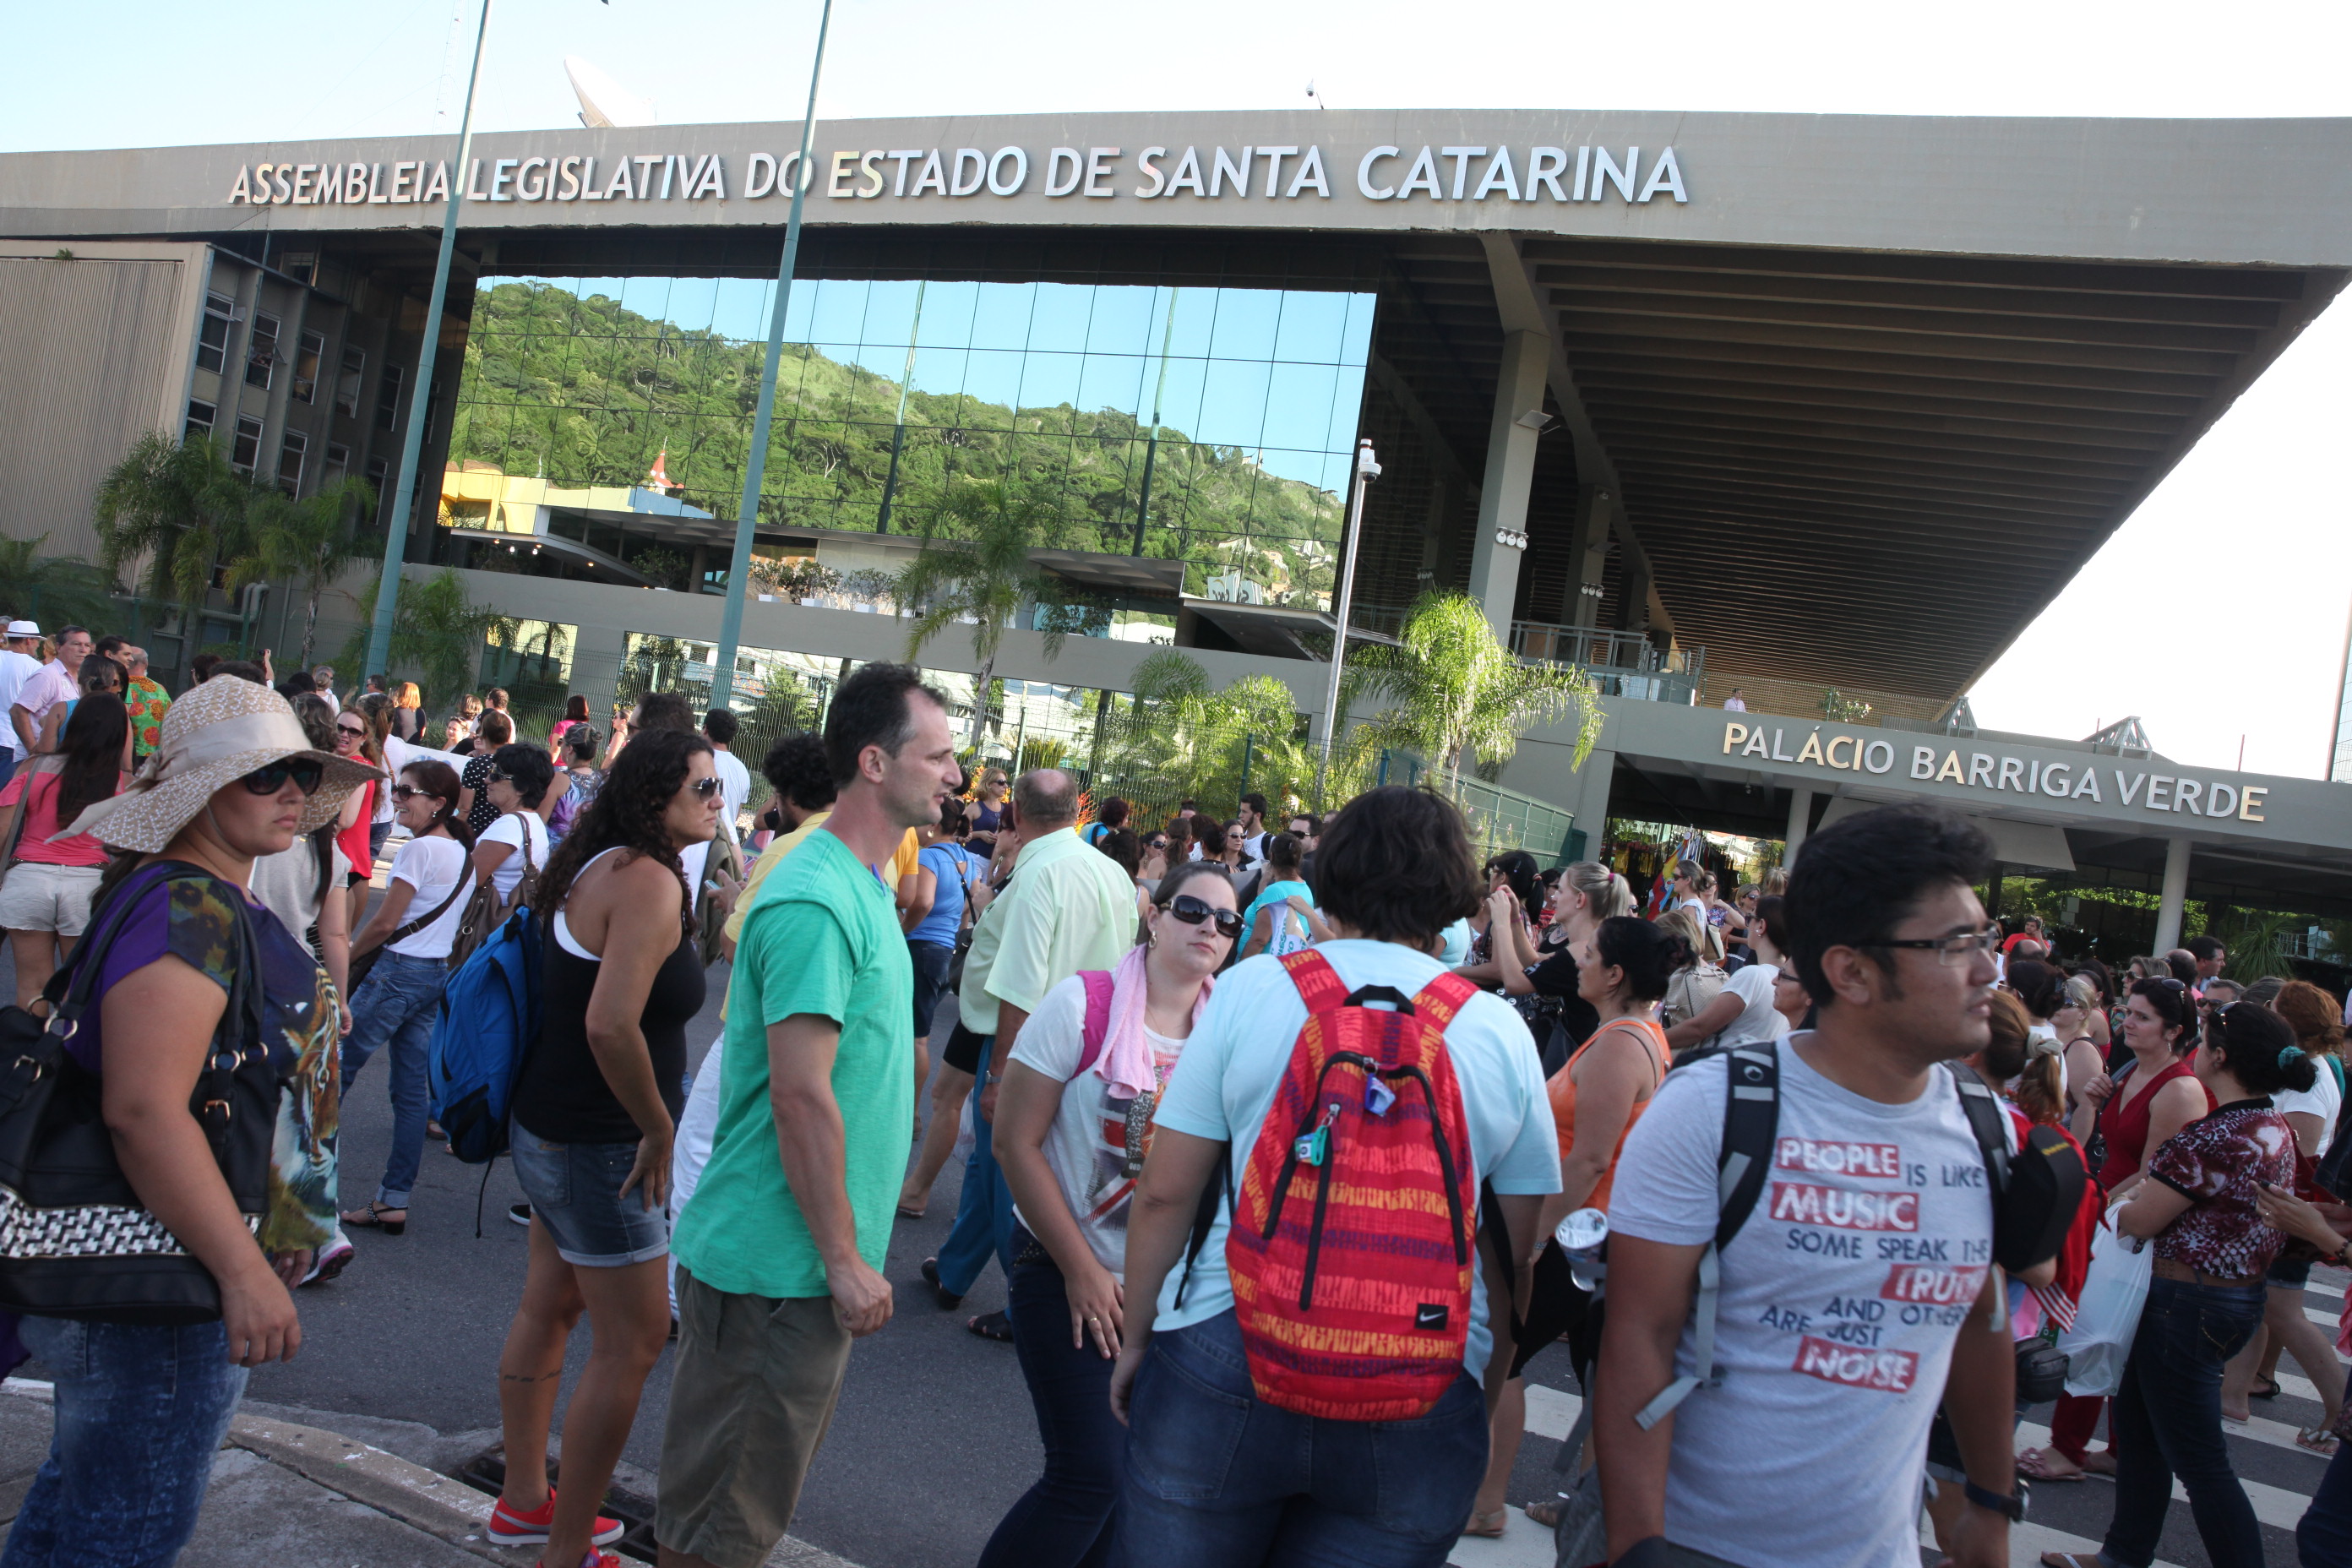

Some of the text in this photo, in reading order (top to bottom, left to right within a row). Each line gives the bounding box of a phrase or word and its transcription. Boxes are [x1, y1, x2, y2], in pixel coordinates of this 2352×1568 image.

[228, 144, 1689, 204] ASSEMBLEIA LEGISLATIVA DO ESTADO DE SANTA CATARINA
[1722, 721, 2268, 823] PALÁCIO BARRIGA VERDE
[1780, 1139, 1984, 1188] PEOPLE IS LIKE
[1774, 1184, 1916, 1231] MUSIC
[1786, 1228, 1989, 1263] SOME SPEAK THE
[1758, 1304, 1884, 1347] ARE JUST
[1821, 1296, 1970, 1327] AND OTHER
[1802, 1344, 1913, 1390] NOISE
